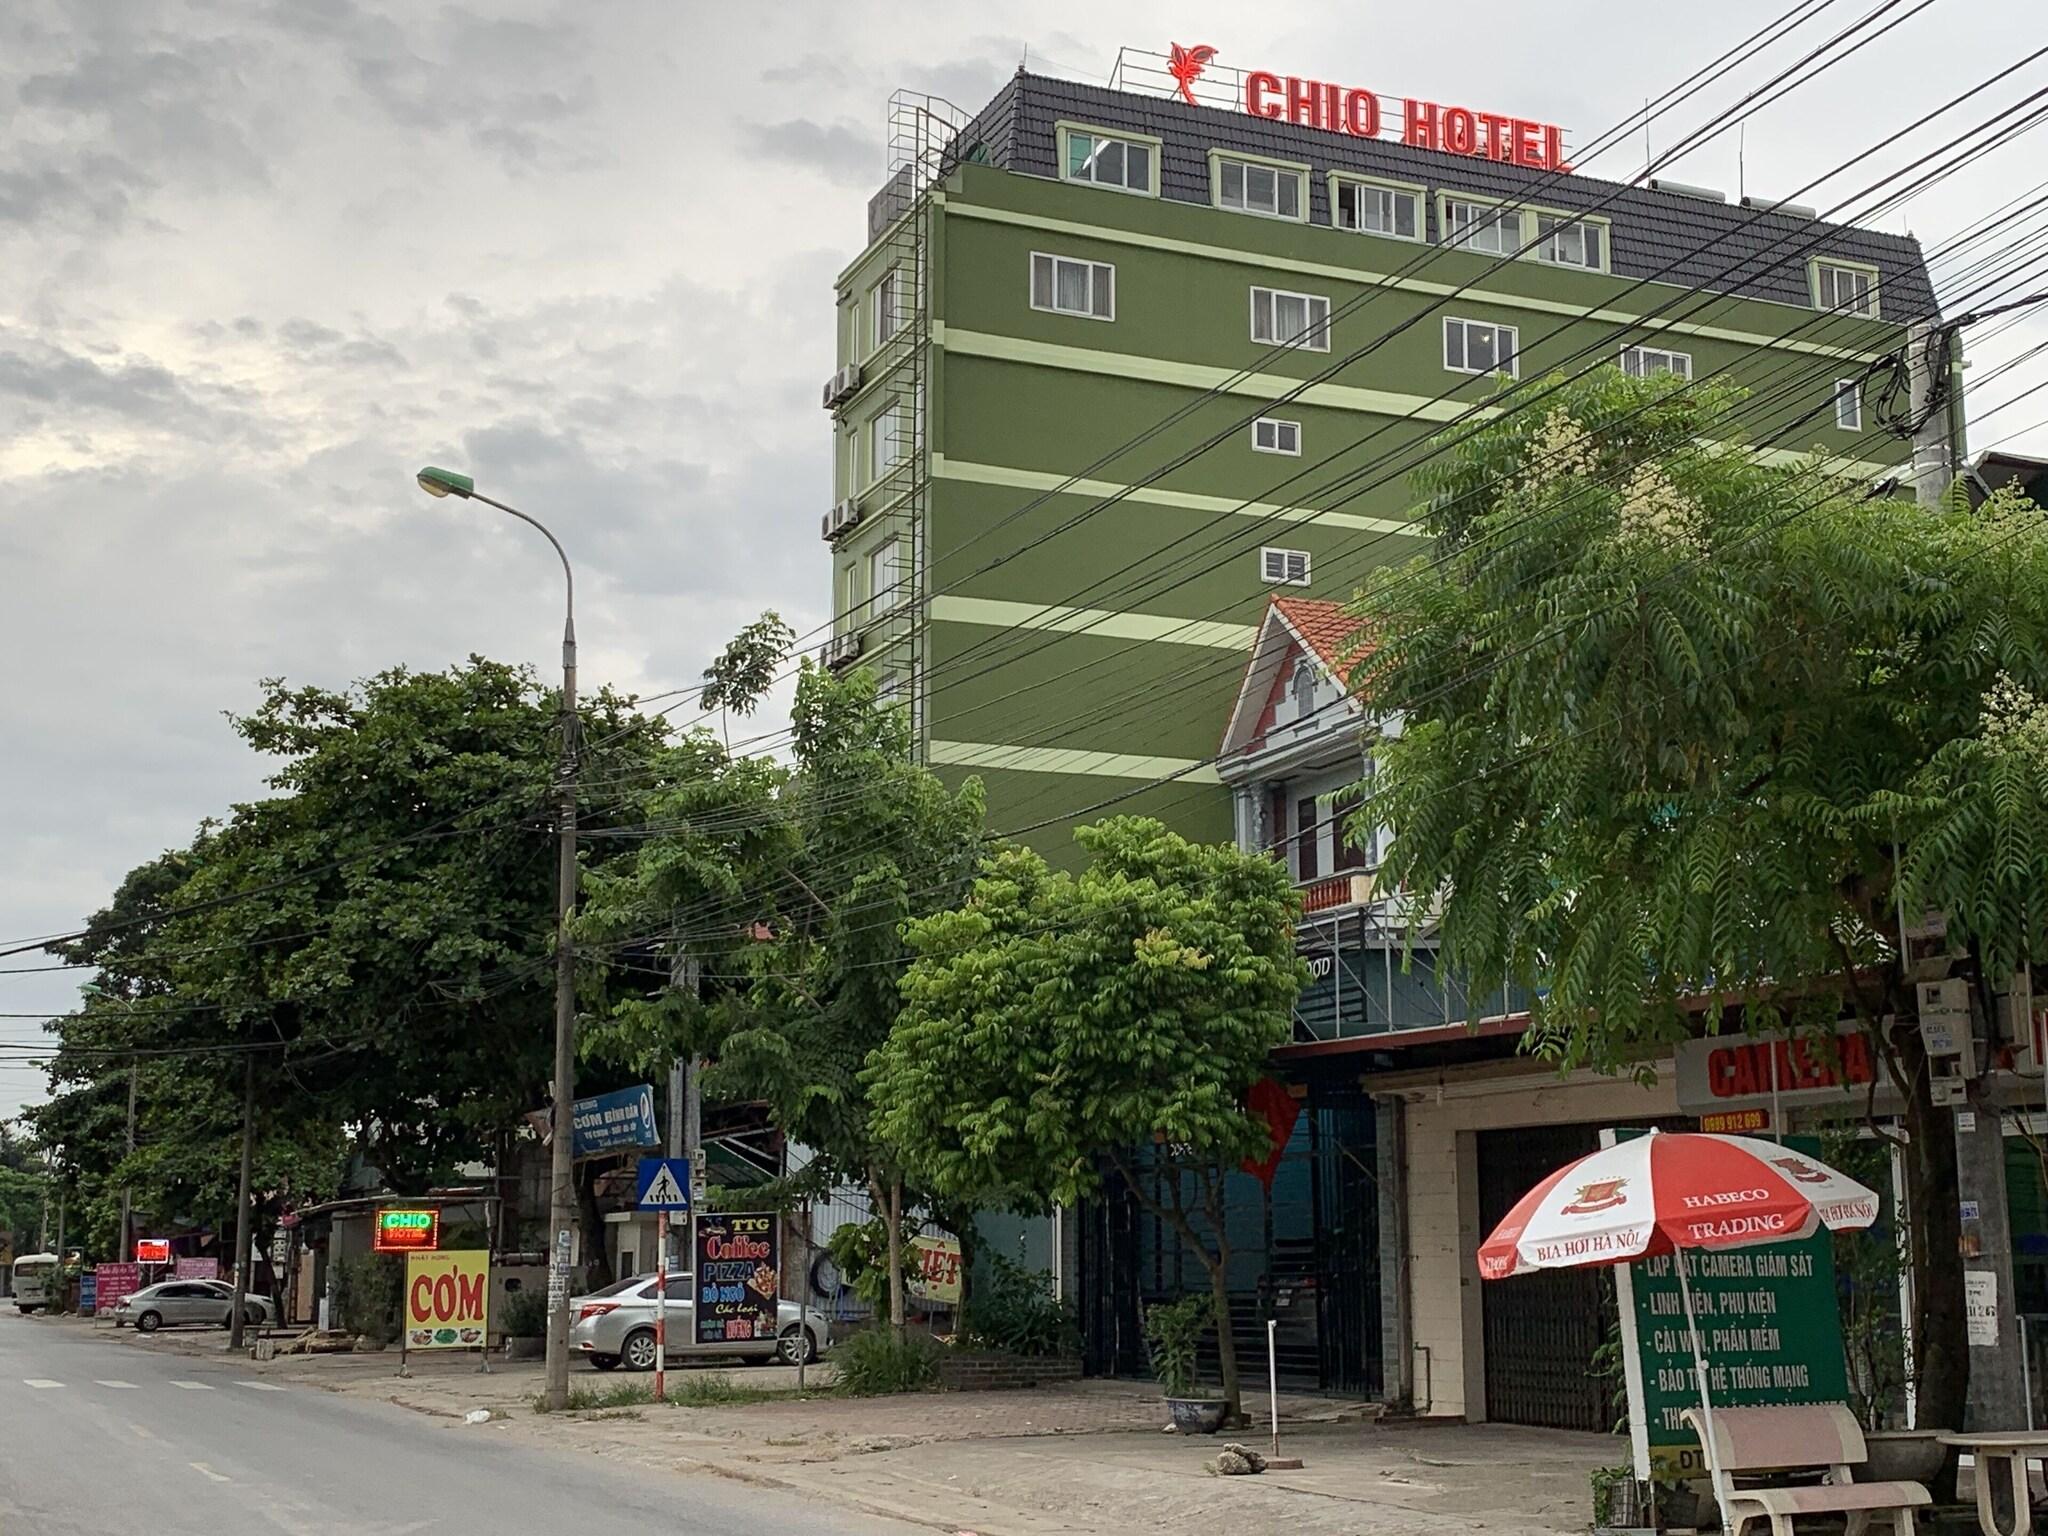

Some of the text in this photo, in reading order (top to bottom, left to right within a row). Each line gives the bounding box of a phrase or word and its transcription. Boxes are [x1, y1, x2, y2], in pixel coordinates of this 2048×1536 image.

[1246, 71, 1573, 172] CHIO HOTEL
[1726, 1113, 1743, 1130] 912
[1681, 1188, 1770, 1209] HABECO
[385, 1212, 432, 1229] CHIO
[731, 1218, 770, 1232] TTG
[1688, 1213, 1785, 1240] TRADING
[707, 1234, 771, 1260] Coffee
[1537, 1245, 1562, 1262] BIA
[1592, 1232, 1613, 1252] HÀ
[703, 1261, 755, 1283] PIZZA
[1701, 1254, 1754, 1278] CAMERA
[1756, 1250, 1788, 1278] GIÁM
[1790, 1250, 1813, 1278] SÁT
[410, 1264, 486, 1323] CƠM
[1650, 1287, 1777, 1320] LINH IỆN, PHỤ KIỆN
[1654, 1325, 1677, 1353] CÀI
[1679, 1329, 1712, 1355] WN,
[1658, 1359, 1685, 1392] BẢO
[1711, 1362, 1729, 1395] HỆ
[1729, 1358, 1771, 1390] THỐNG
[1773, 1364, 1809, 1393] MẠNG
